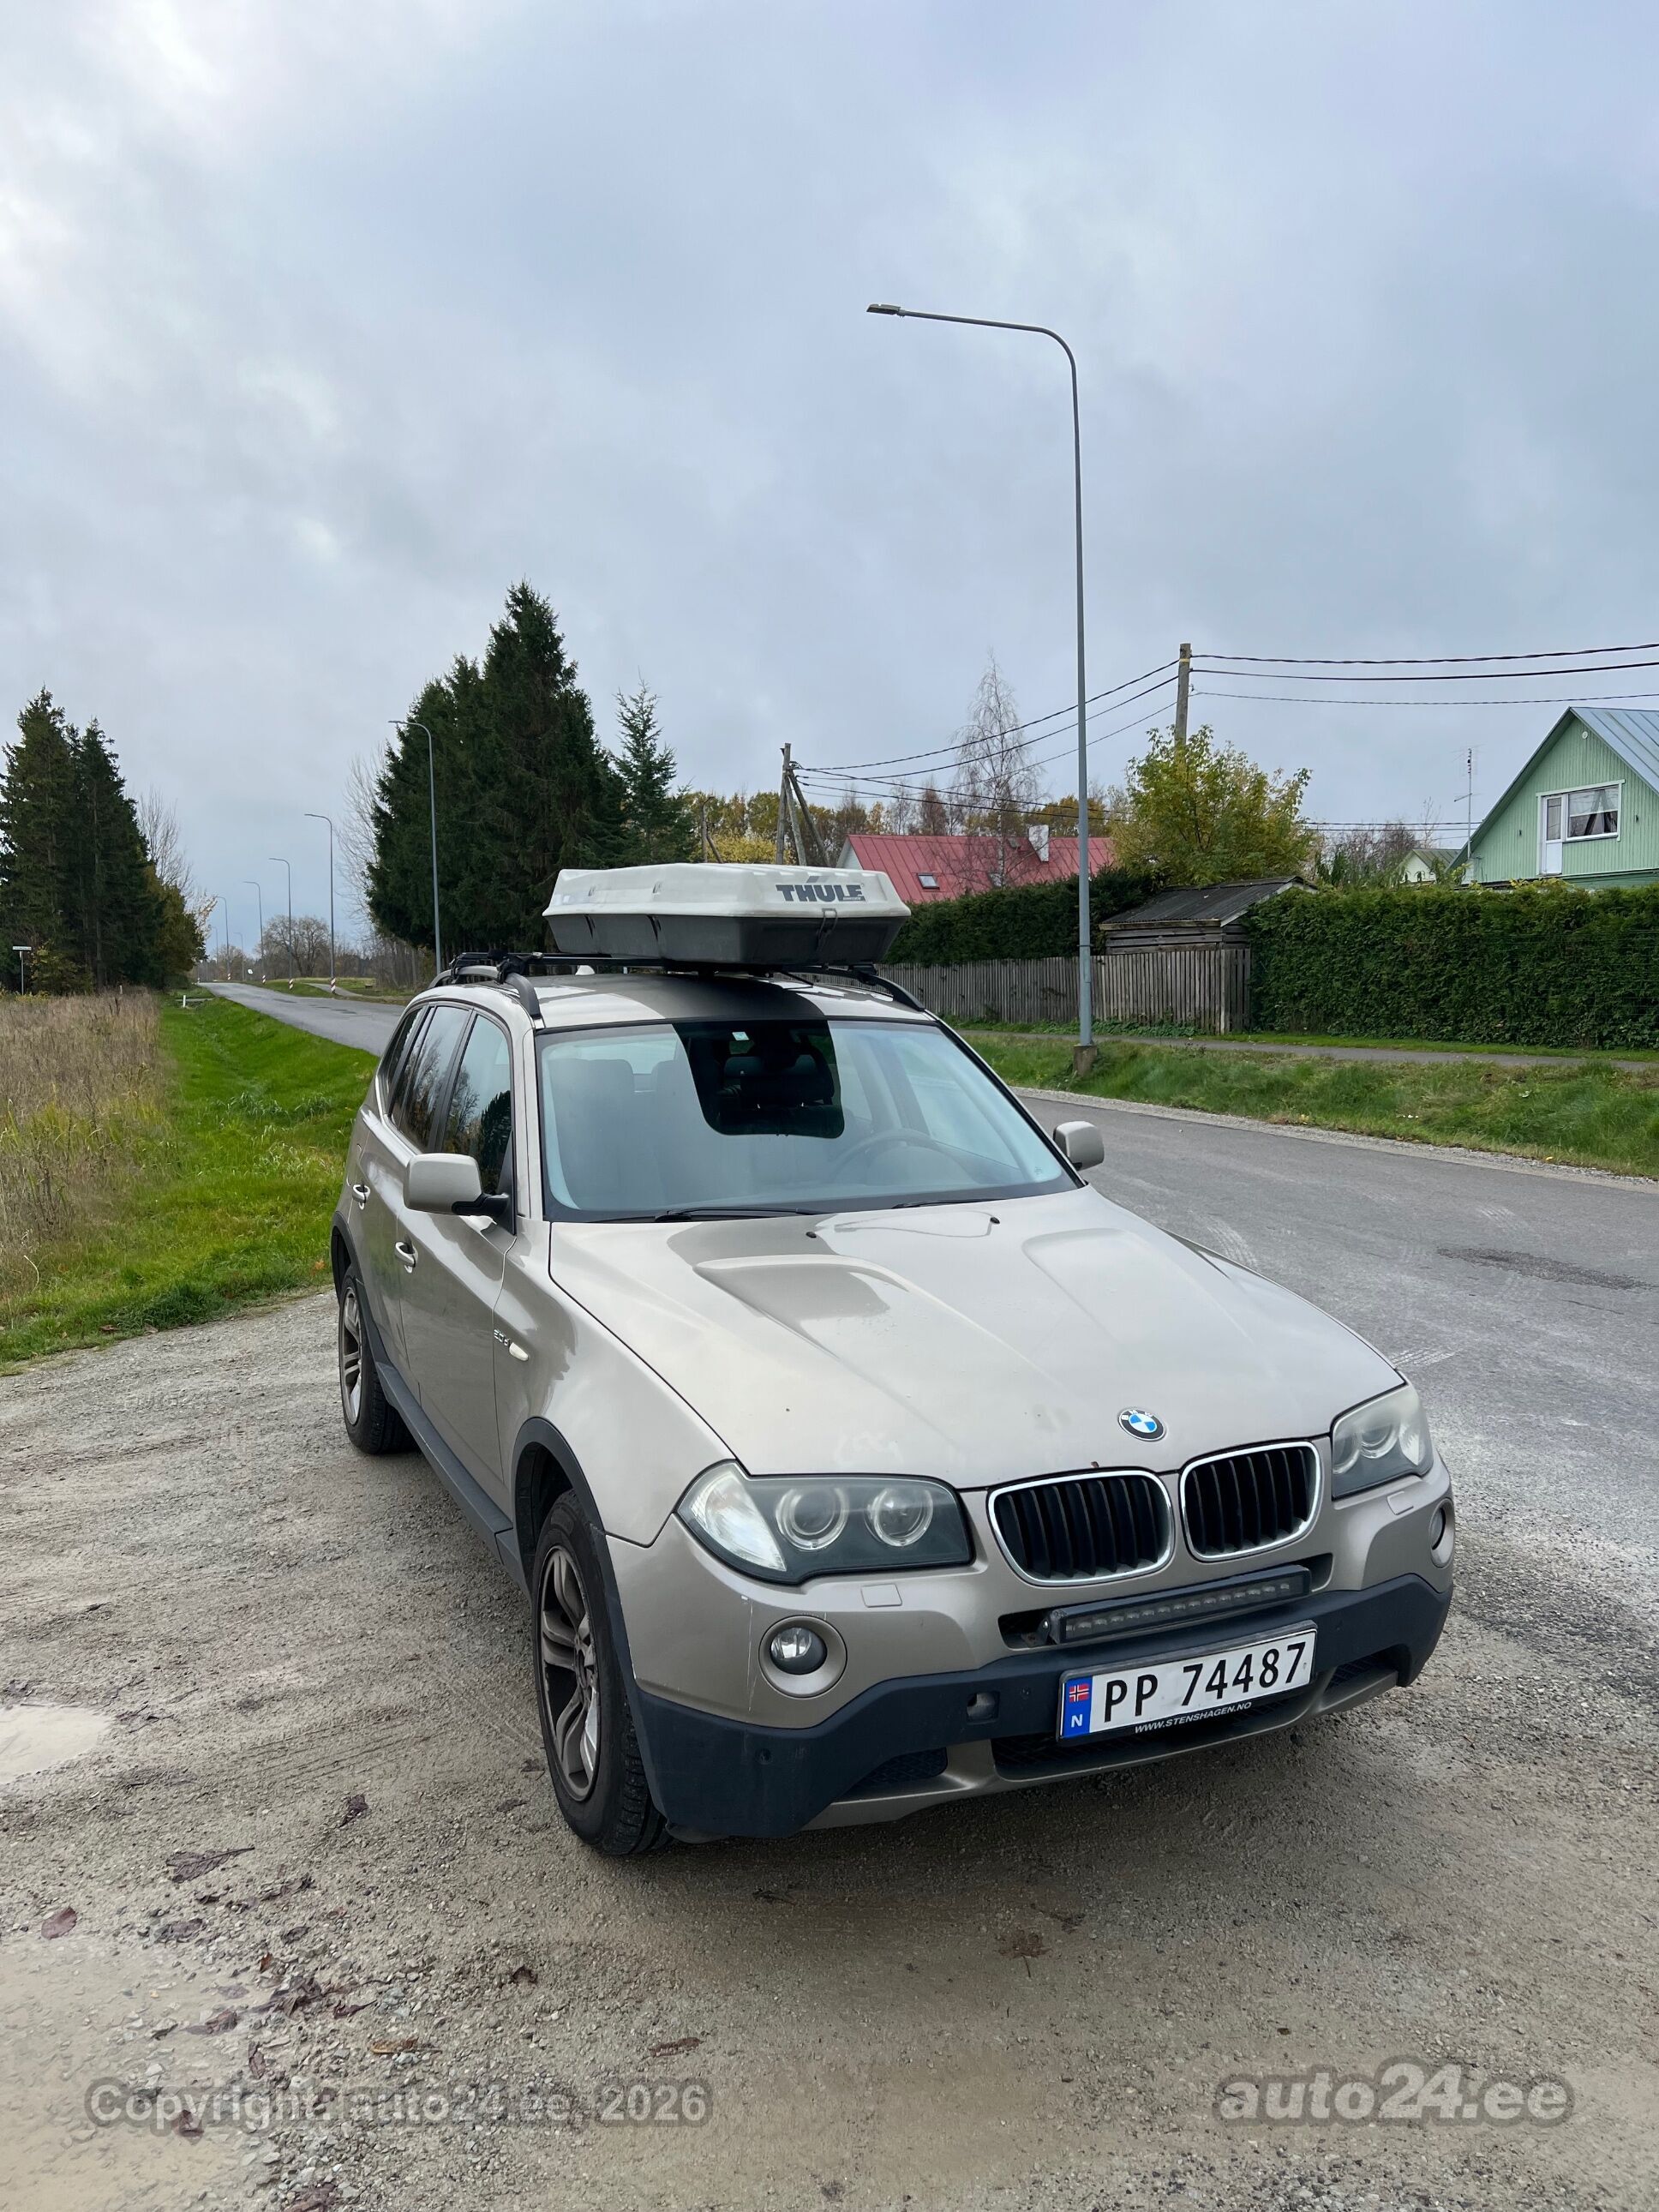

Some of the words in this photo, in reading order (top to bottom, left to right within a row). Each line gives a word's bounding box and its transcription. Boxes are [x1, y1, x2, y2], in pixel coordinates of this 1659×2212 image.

[775, 884, 866, 902] THULE
[1104, 1674, 1158, 1723] PP
[1181, 1641, 1306, 1706] 74487
[1070, 1714, 1083, 1728] N
[1135, 1701, 1252, 1734] WWW.STENSHAGEN.NO
